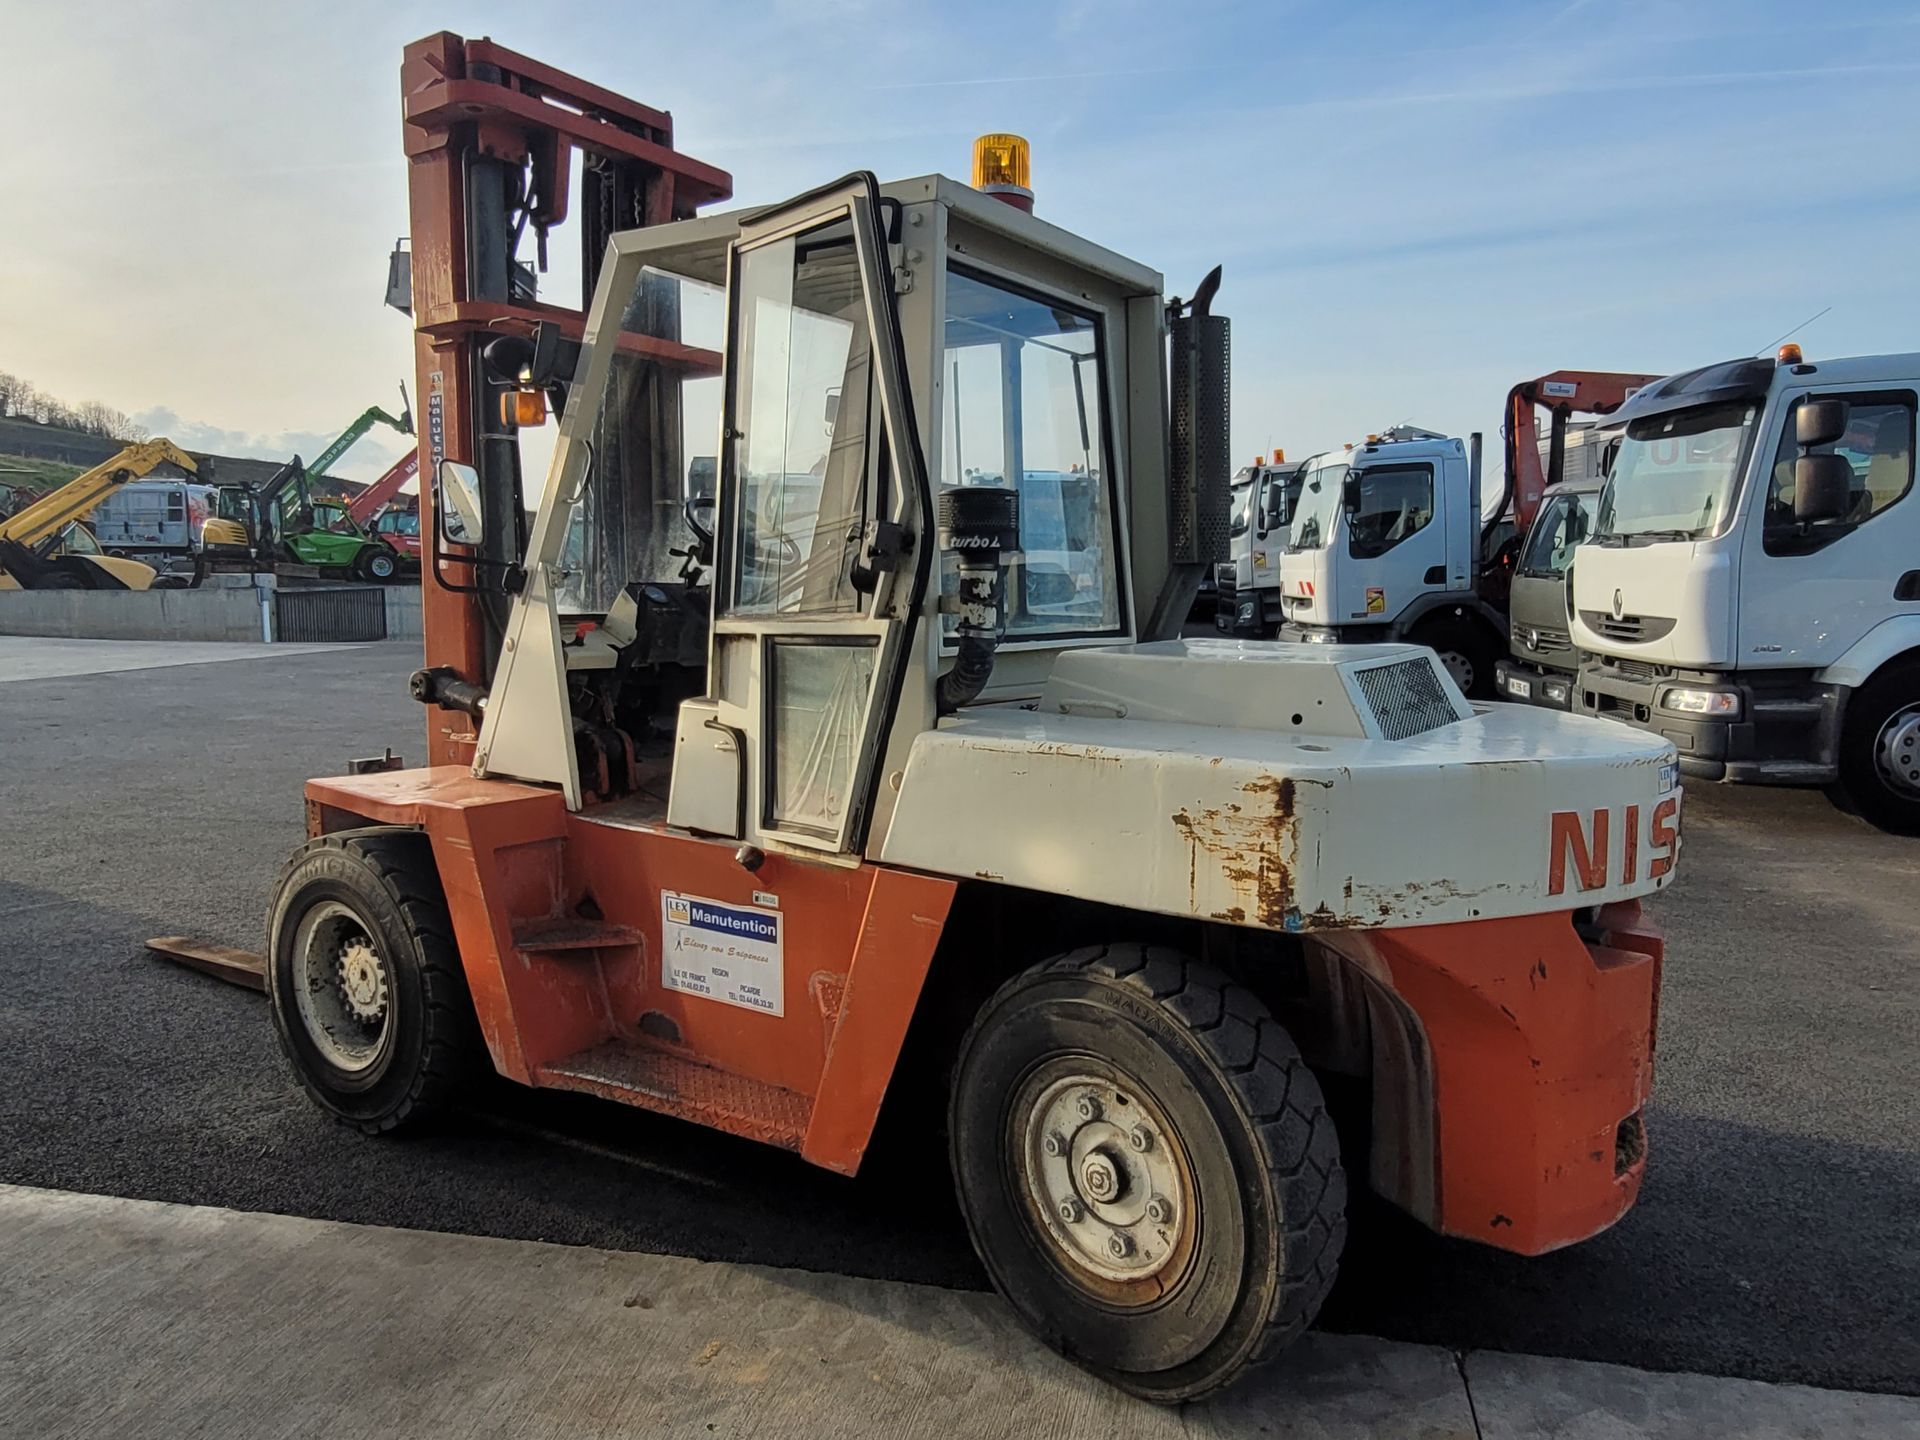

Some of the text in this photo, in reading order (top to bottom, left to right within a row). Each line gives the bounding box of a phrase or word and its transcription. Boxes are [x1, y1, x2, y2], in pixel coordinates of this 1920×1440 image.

[405, 460, 417, 475] MA
[950, 535, 990, 549] turbo
[1548, 797, 1676, 896] NIS
[669, 900, 776, 937] LEX Manutention
[682, 971, 688, 979] DE
[689, 972, 707, 984] FRANCE
[712, 967, 729, 978] REGION
[740, 984, 761, 997] PICARDIE
